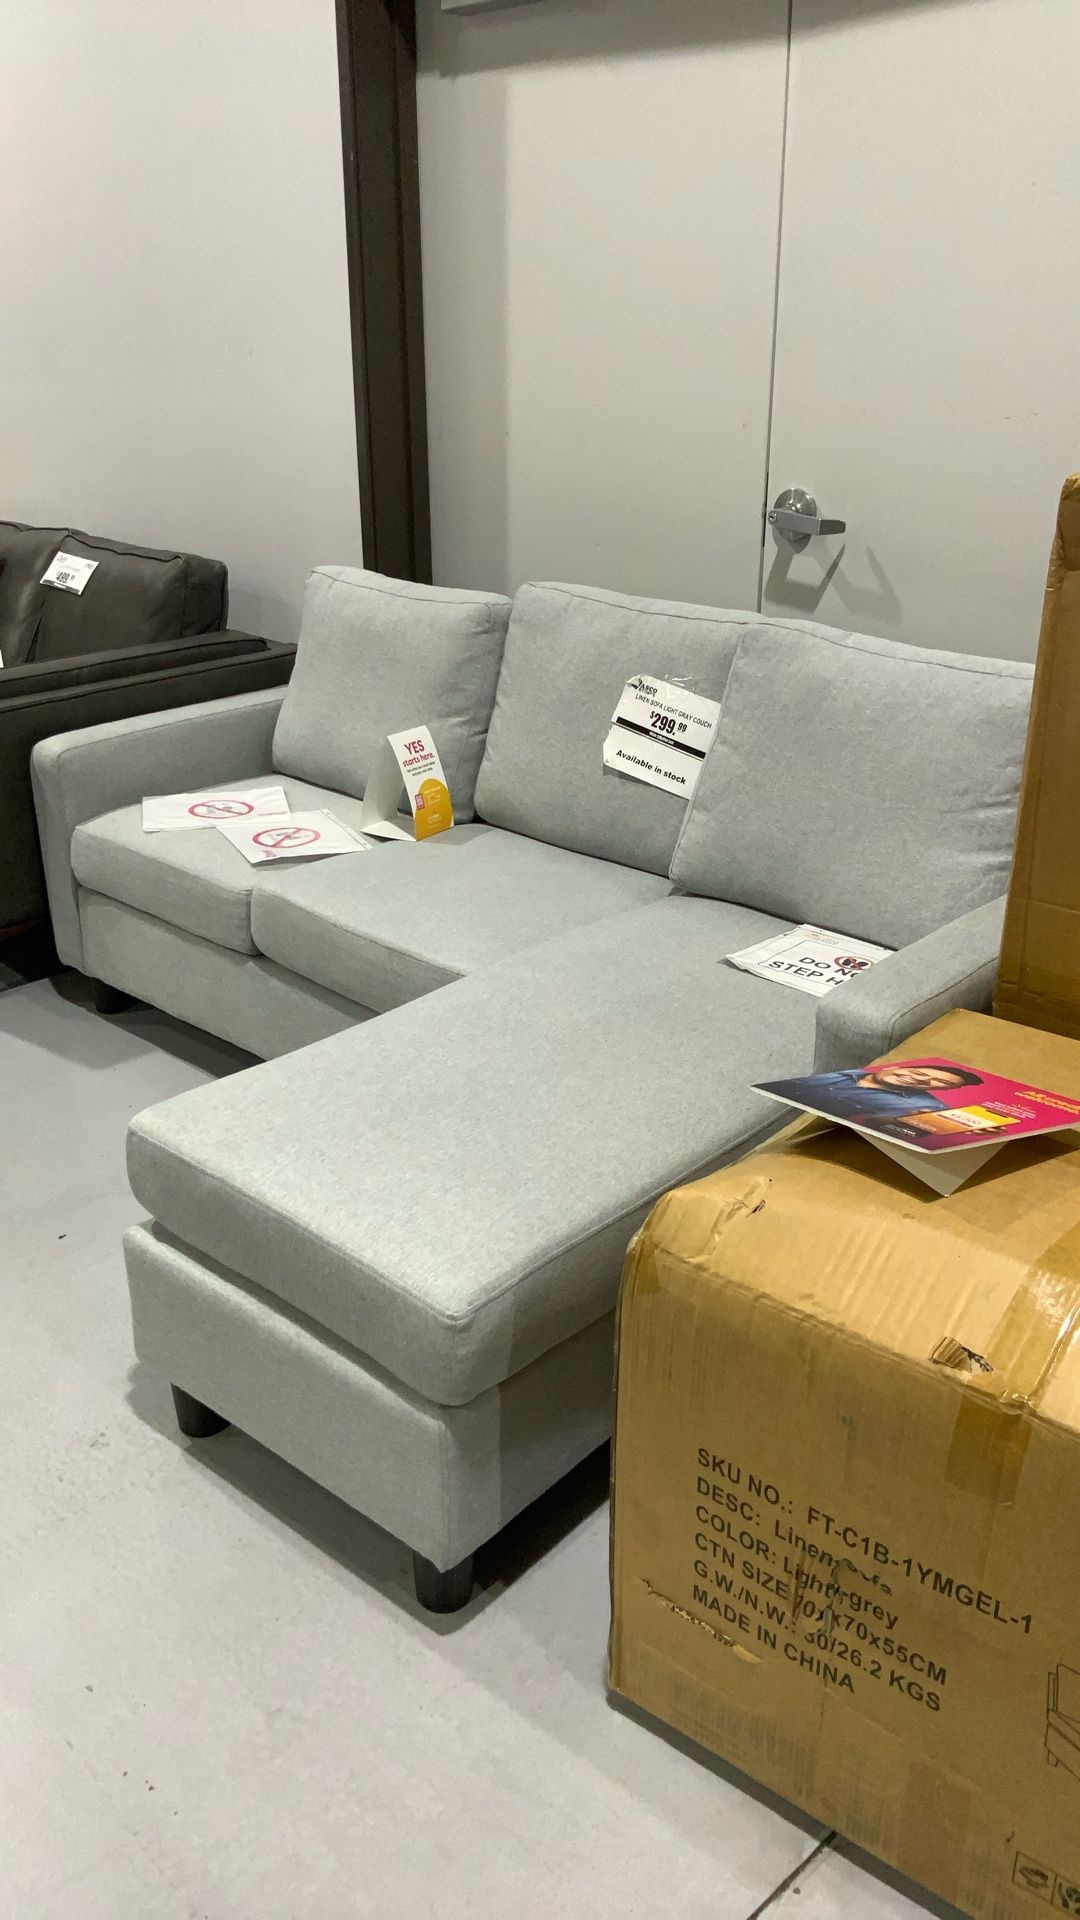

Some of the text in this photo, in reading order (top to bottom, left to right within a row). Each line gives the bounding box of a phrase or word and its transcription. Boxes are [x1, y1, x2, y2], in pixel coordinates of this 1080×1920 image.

[635, 693, 650, 704] LINEN
[650, 700, 663, 709] SOFA
[664, 705, 678, 715] LIGHT
[678, 710, 693, 721] GRAY
[693, 717, 712, 729] COUCH
[402, 753, 435, 767] starts here.
[404, 740, 425, 755] YES
[616, 749, 687, 785] Available in stock
[768, 960, 824, 977] STEP
[798, 957, 832, 969] DO
[696, 1505, 777, 1565] COLOR:
[697, 1476, 761, 1526] DESC:
[774, 1519, 834, 1568] Linen
[694, 1532, 735, 1569] CTN
[698, 1448, 1032, 1634] SKU NO.: FT-C1B-1YMGEL-1
[692, 1584, 855, 1693] MADE IN CHINA
[693, 1560, 797, 1635] G.W./N.W.:
[889, 1669, 941, 1712] KGS
